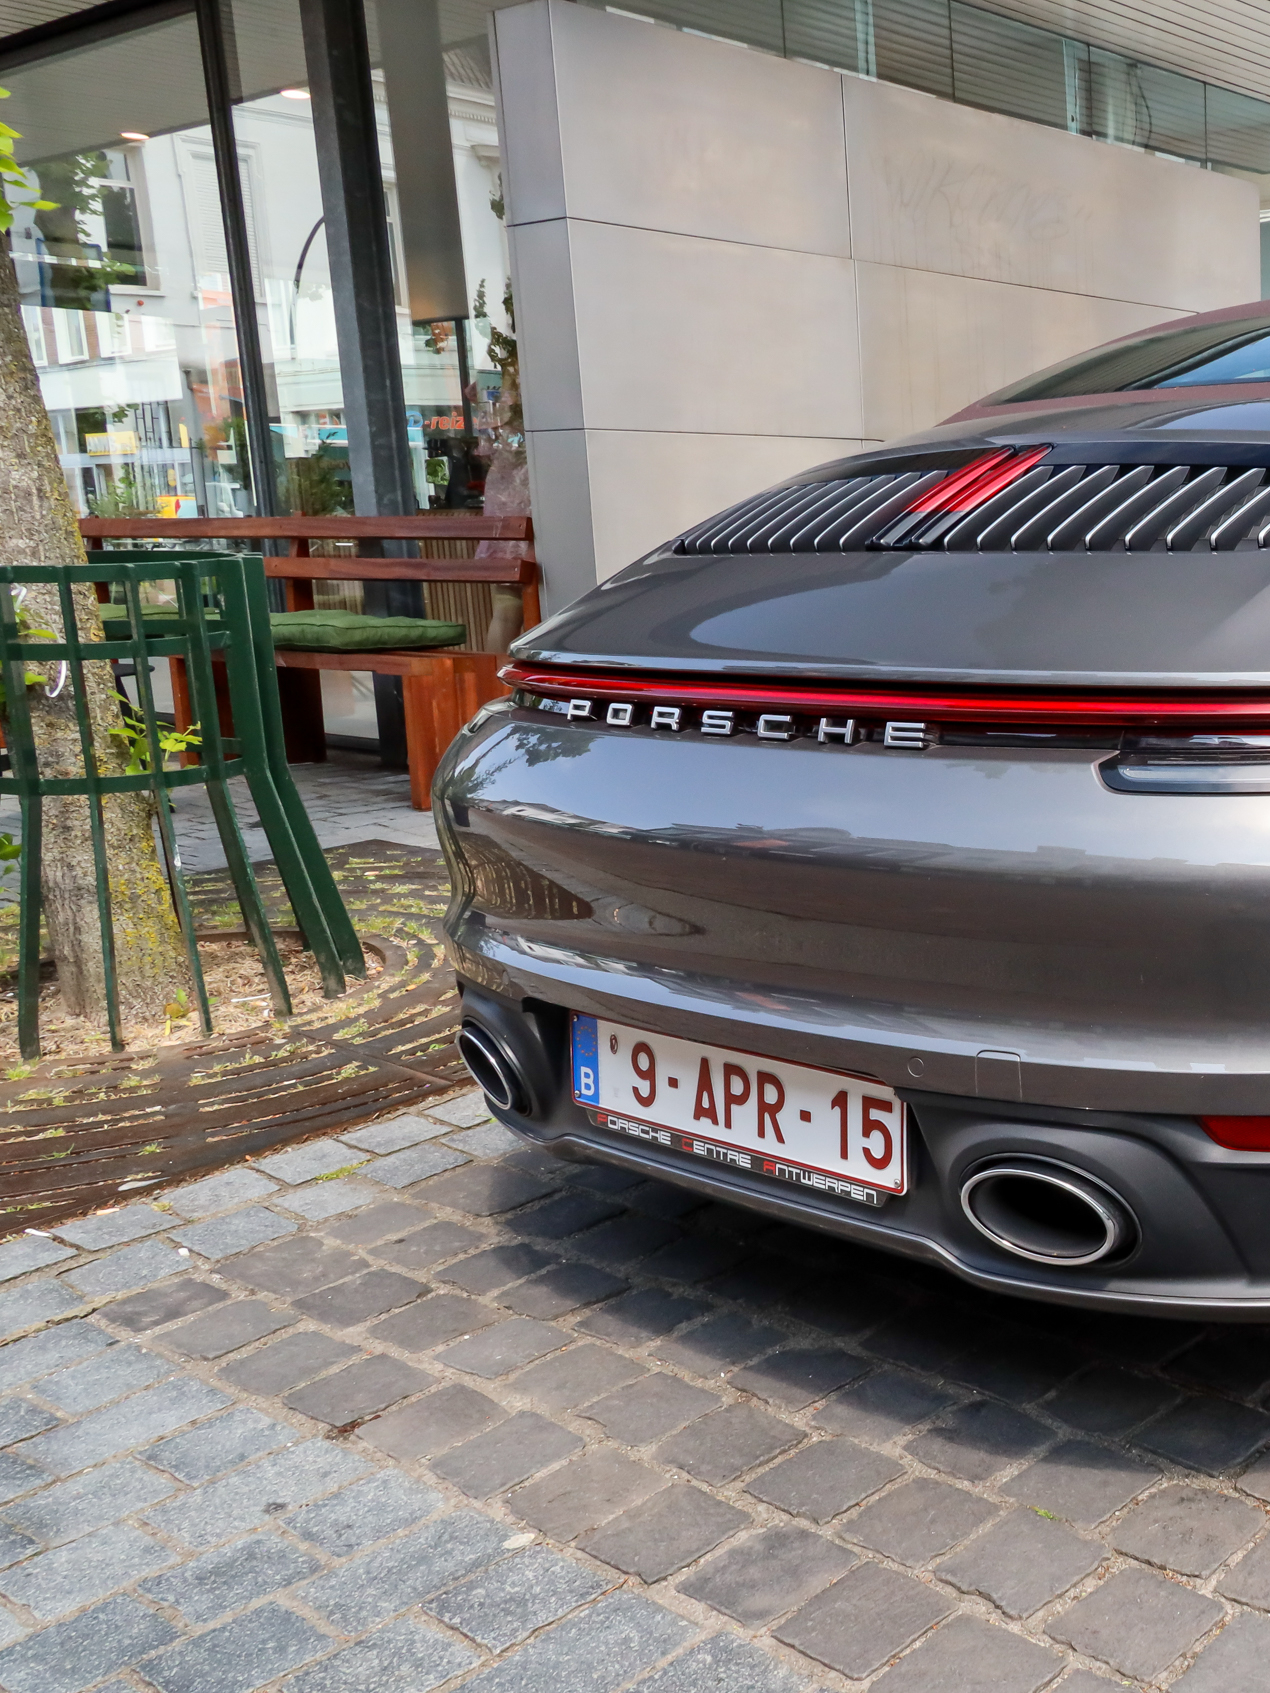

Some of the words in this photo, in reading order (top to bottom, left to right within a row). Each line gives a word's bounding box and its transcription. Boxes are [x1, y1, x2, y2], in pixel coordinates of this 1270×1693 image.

[567, 699, 927, 749] PORSCHE
[580, 1066, 596, 1097] B
[630, 1042, 894, 1171] 9-APR-15
[596, 1112, 672, 1146] PORSCHE
[681, 1137, 752, 1169] CENTRE
[763, 1160, 878, 1205] ANTWERPEN
